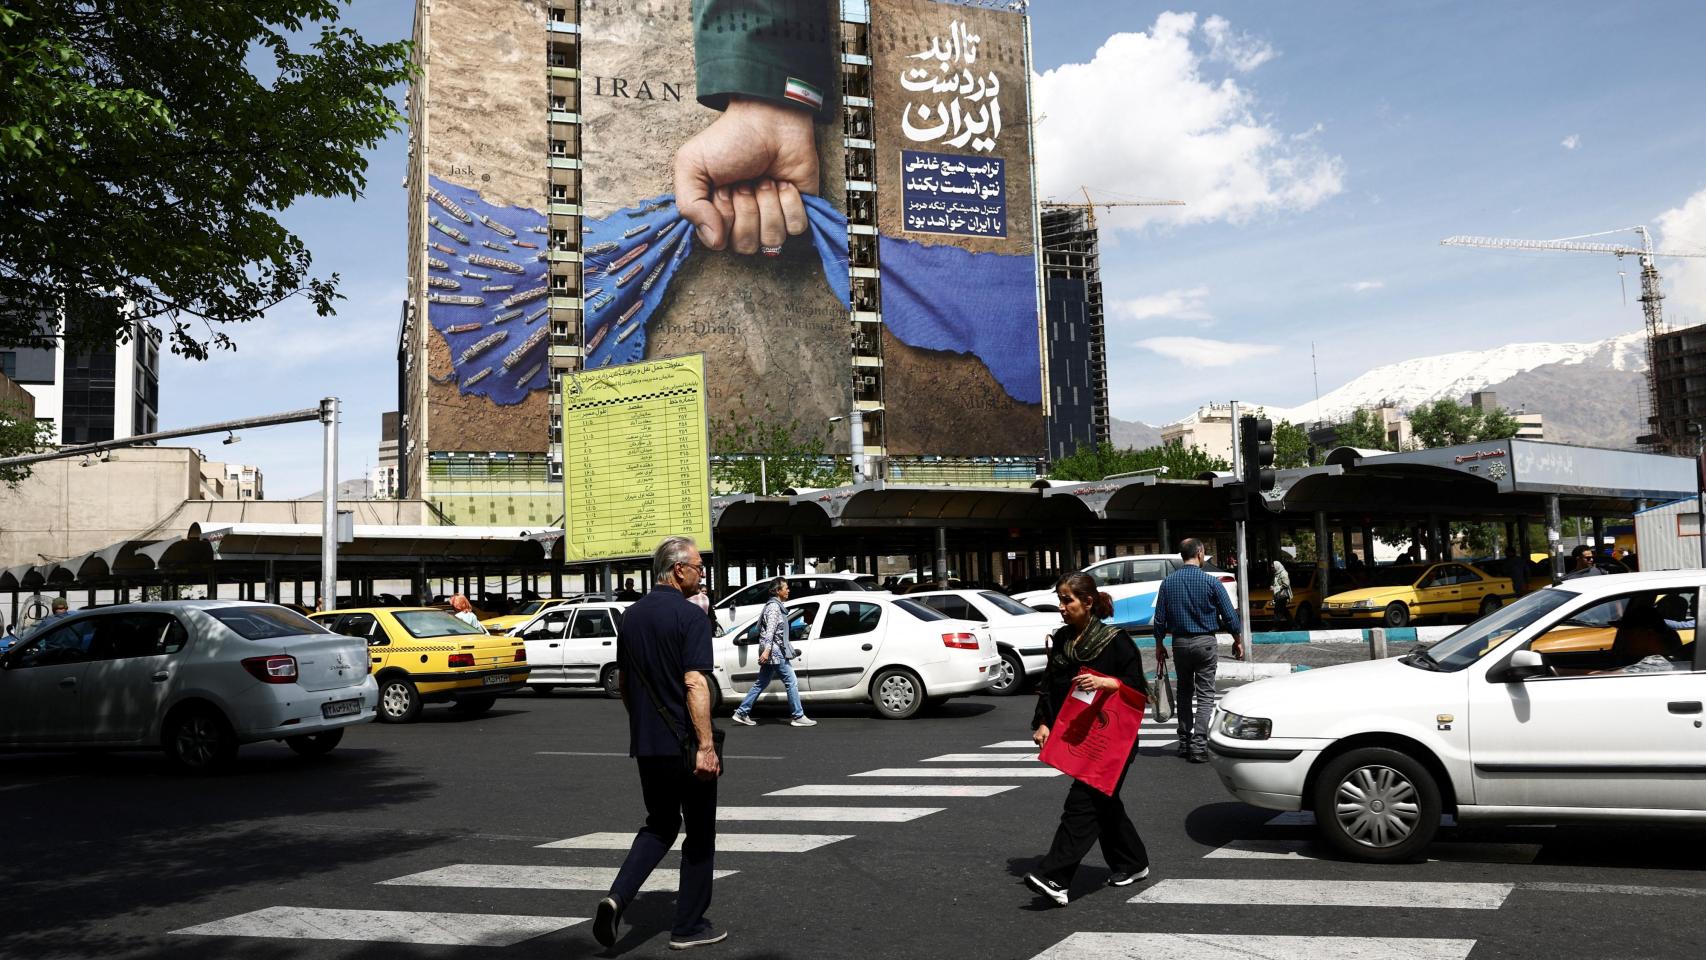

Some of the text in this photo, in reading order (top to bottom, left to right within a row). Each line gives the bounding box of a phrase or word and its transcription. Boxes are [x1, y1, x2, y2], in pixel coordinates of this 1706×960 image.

[905, 19, 980, 73] تا ابد
[594, 76, 681, 102] IRAN
[900, 67, 1000, 102] در دست
[901, 96, 1002, 153] ایران
[448, 164, 475, 176] Jask
[905, 156, 1000, 179] ترامپ هیچ غلطی
[906, 176, 1000, 200] نتوانست بکند
[908, 200, 927, 211] هرمز
[980, 204, 1002, 215] کنترل
[908, 214, 1001, 233] با ایران خواهد بود
